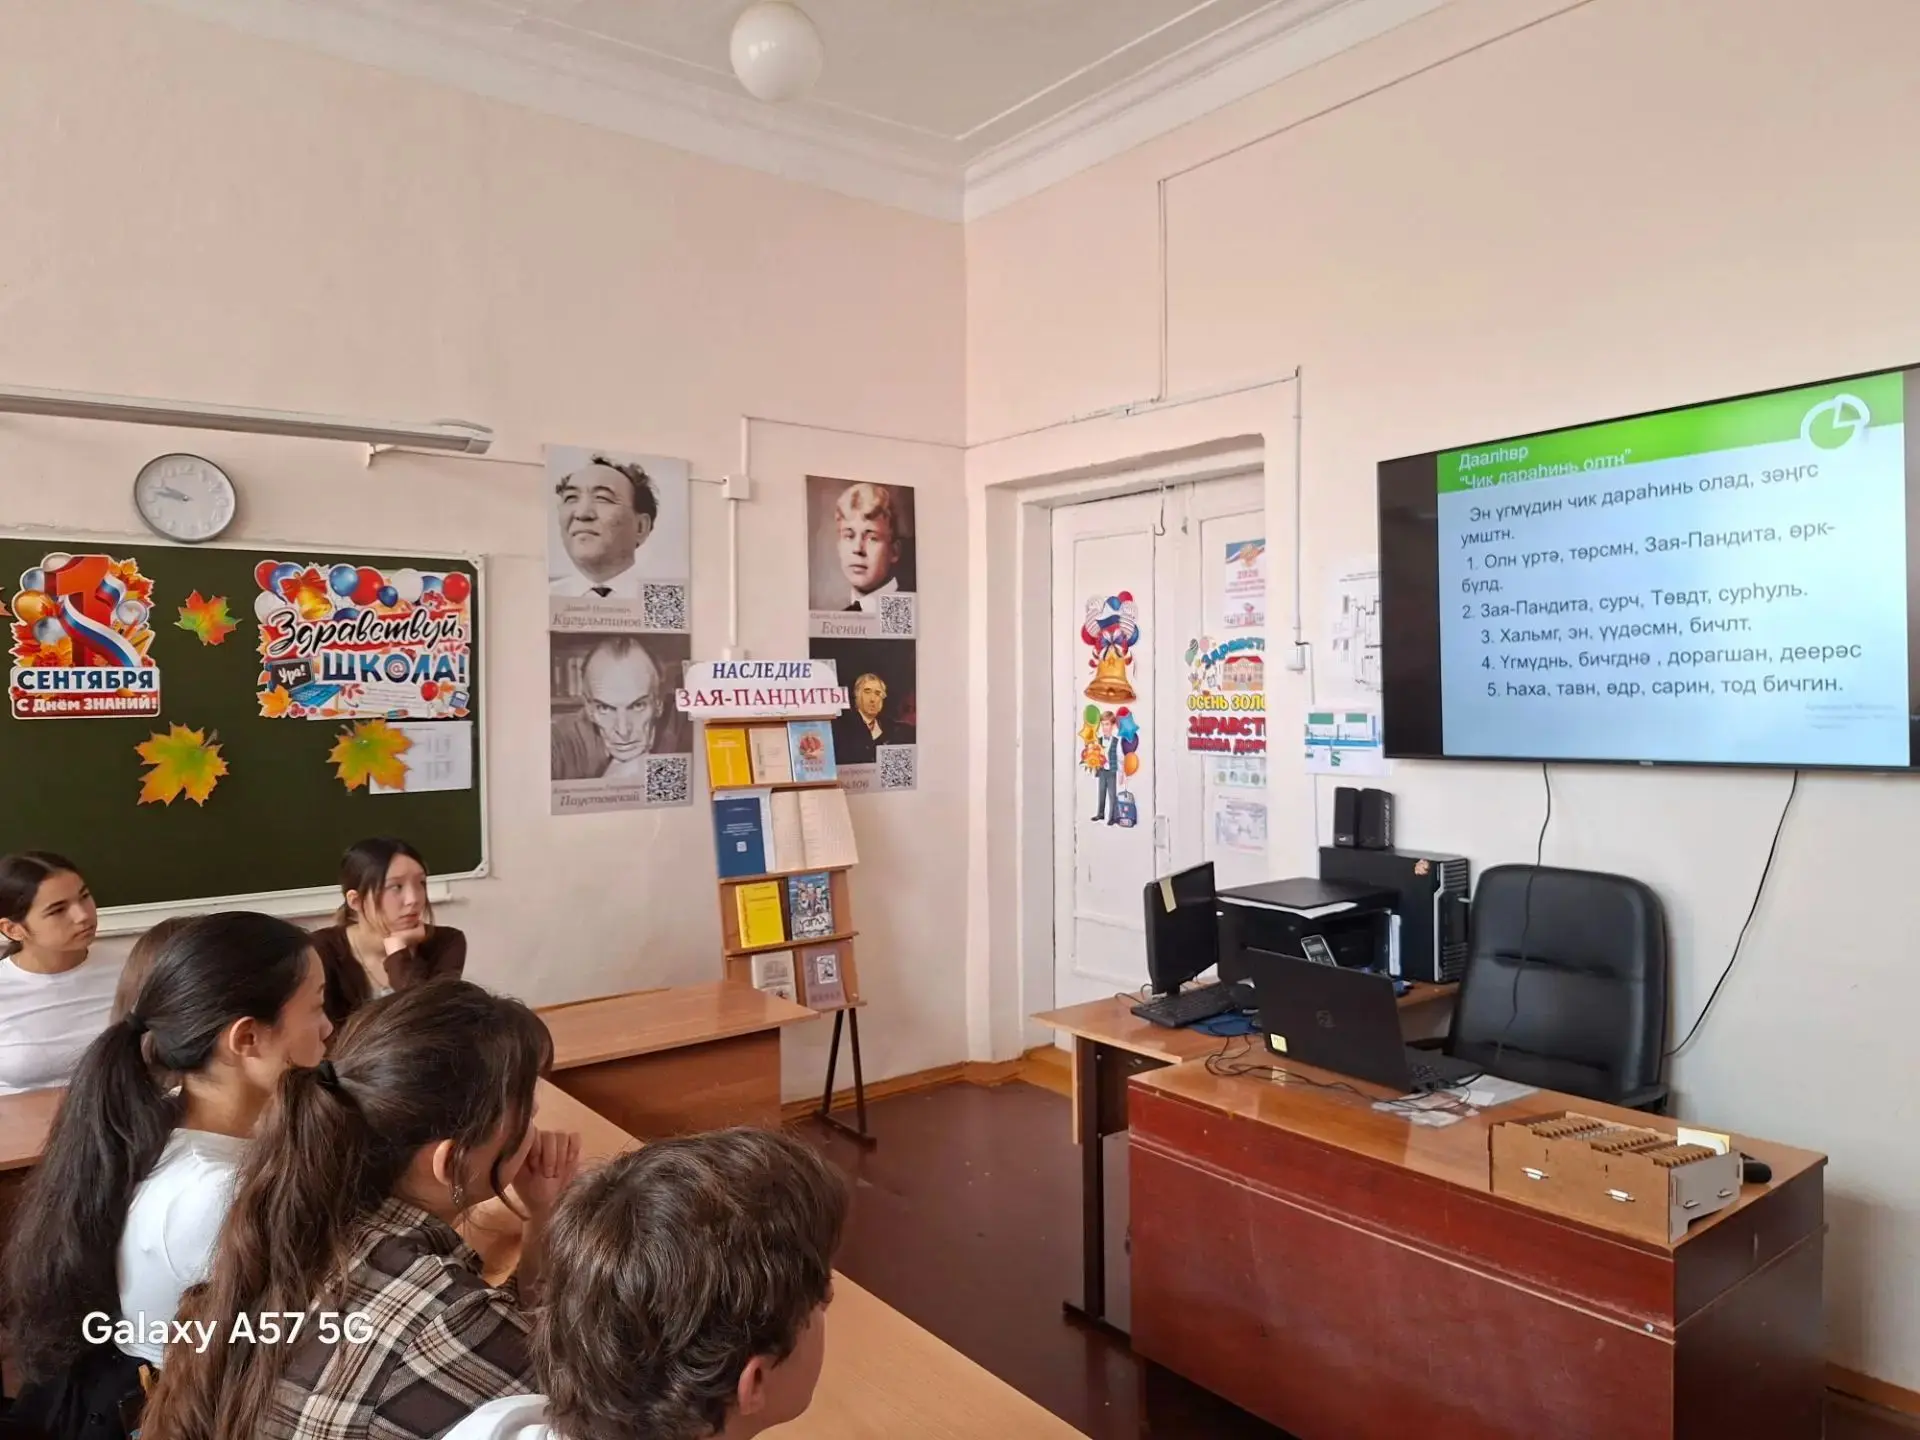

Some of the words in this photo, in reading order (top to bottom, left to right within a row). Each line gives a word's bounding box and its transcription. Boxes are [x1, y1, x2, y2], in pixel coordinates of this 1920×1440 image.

[1470, 507, 1491, 522] Эн
[1568, 493, 1597, 508] чик
[1466, 556, 1479, 570] 1.
[1645, 527, 1782, 553] Зая-Пандита,
[1481, 598, 1594, 618] Зая-Пандита,
[1599, 594, 1645, 612] сурч,
[269, 608, 463, 655] Здравствуй,
[821, 621, 867, 635] Есенин
[1481, 630, 1495, 645] 3.
[1500, 627, 1563, 643] Хальмг,
[1568, 627, 1594, 640] эн,
[322, 653, 466, 684] ШКОЛА!
[1481, 656, 1495, 670] 4.
[1668, 646, 1773, 669] дорагшан,
[17, 670, 153, 690] СЕНТЯБРЯ
[278, 664, 307, 685] Ура!
[712, 662, 812, 680] НАСЛЕДИЕ
[1487, 682, 1500, 697] 5.
[1556, 682, 1600, 698] тавн,
[1652, 679, 1715, 697] сарин,
[1721, 679, 1756, 695] тод
[1763, 675, 1844, 693] бичгин.
[16, 699, 29, 712] С
[83, 694, 158, 711] ЗНАНИЙ!
[679, 687, 850, 708] ЗАЯ-ПАНДИТЫ
[1187, 695, 1229, 711] ОСЕНЬ
[1188, 716, 1266, 737] ЗДРАВСТ
